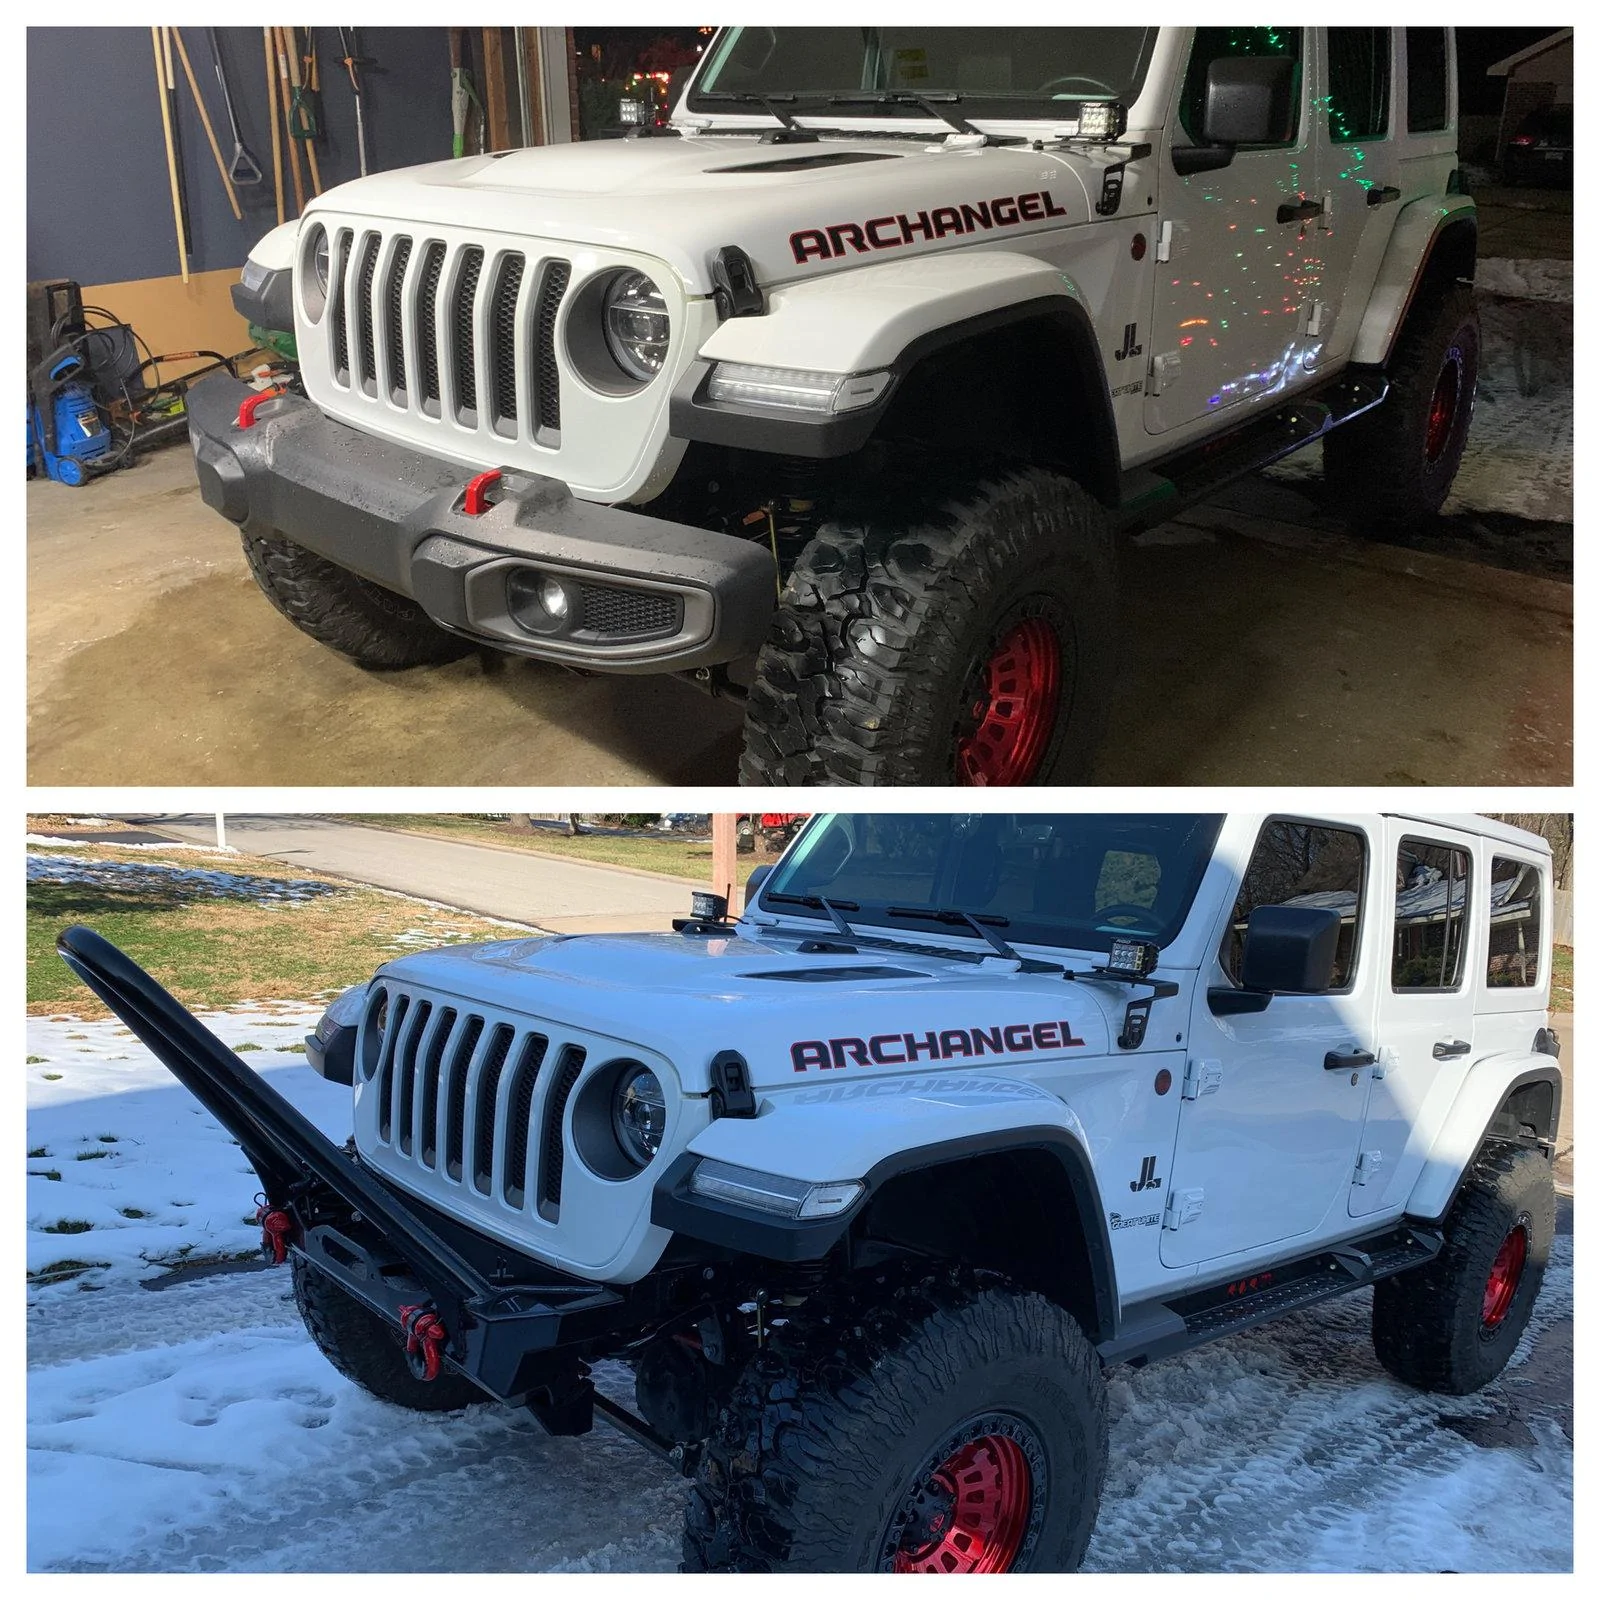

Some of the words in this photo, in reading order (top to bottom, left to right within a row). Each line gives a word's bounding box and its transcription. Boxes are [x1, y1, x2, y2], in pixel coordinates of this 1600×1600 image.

[788, 190, 1067, 264] ARCHANGEL
[789, 1020, 1086, 1072] ARCHANGEL
[1129, 1155, 1162, 1193] JL
